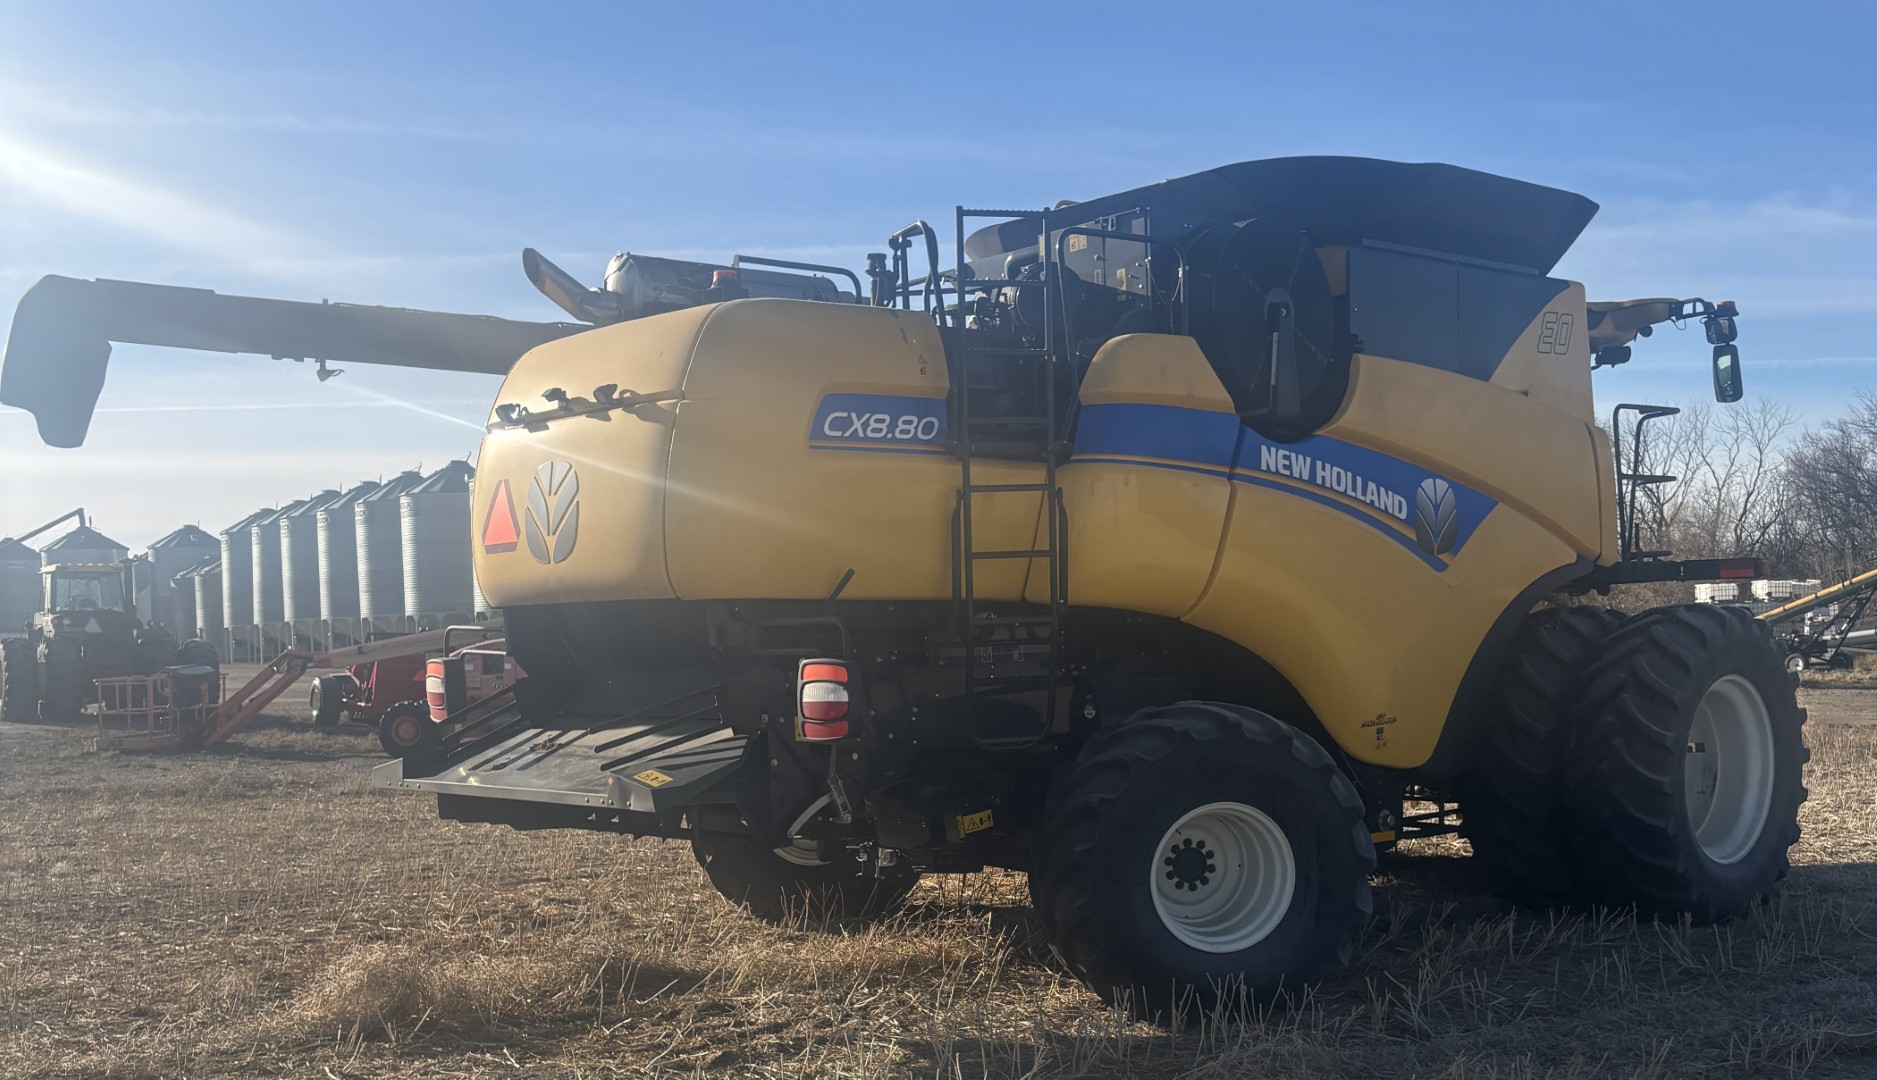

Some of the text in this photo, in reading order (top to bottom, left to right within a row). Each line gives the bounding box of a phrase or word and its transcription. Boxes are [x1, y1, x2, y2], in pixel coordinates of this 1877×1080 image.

[823, 411, 940, 440] CX8.80
[1260, 444, 1408, 520] NEW HOLLAND
